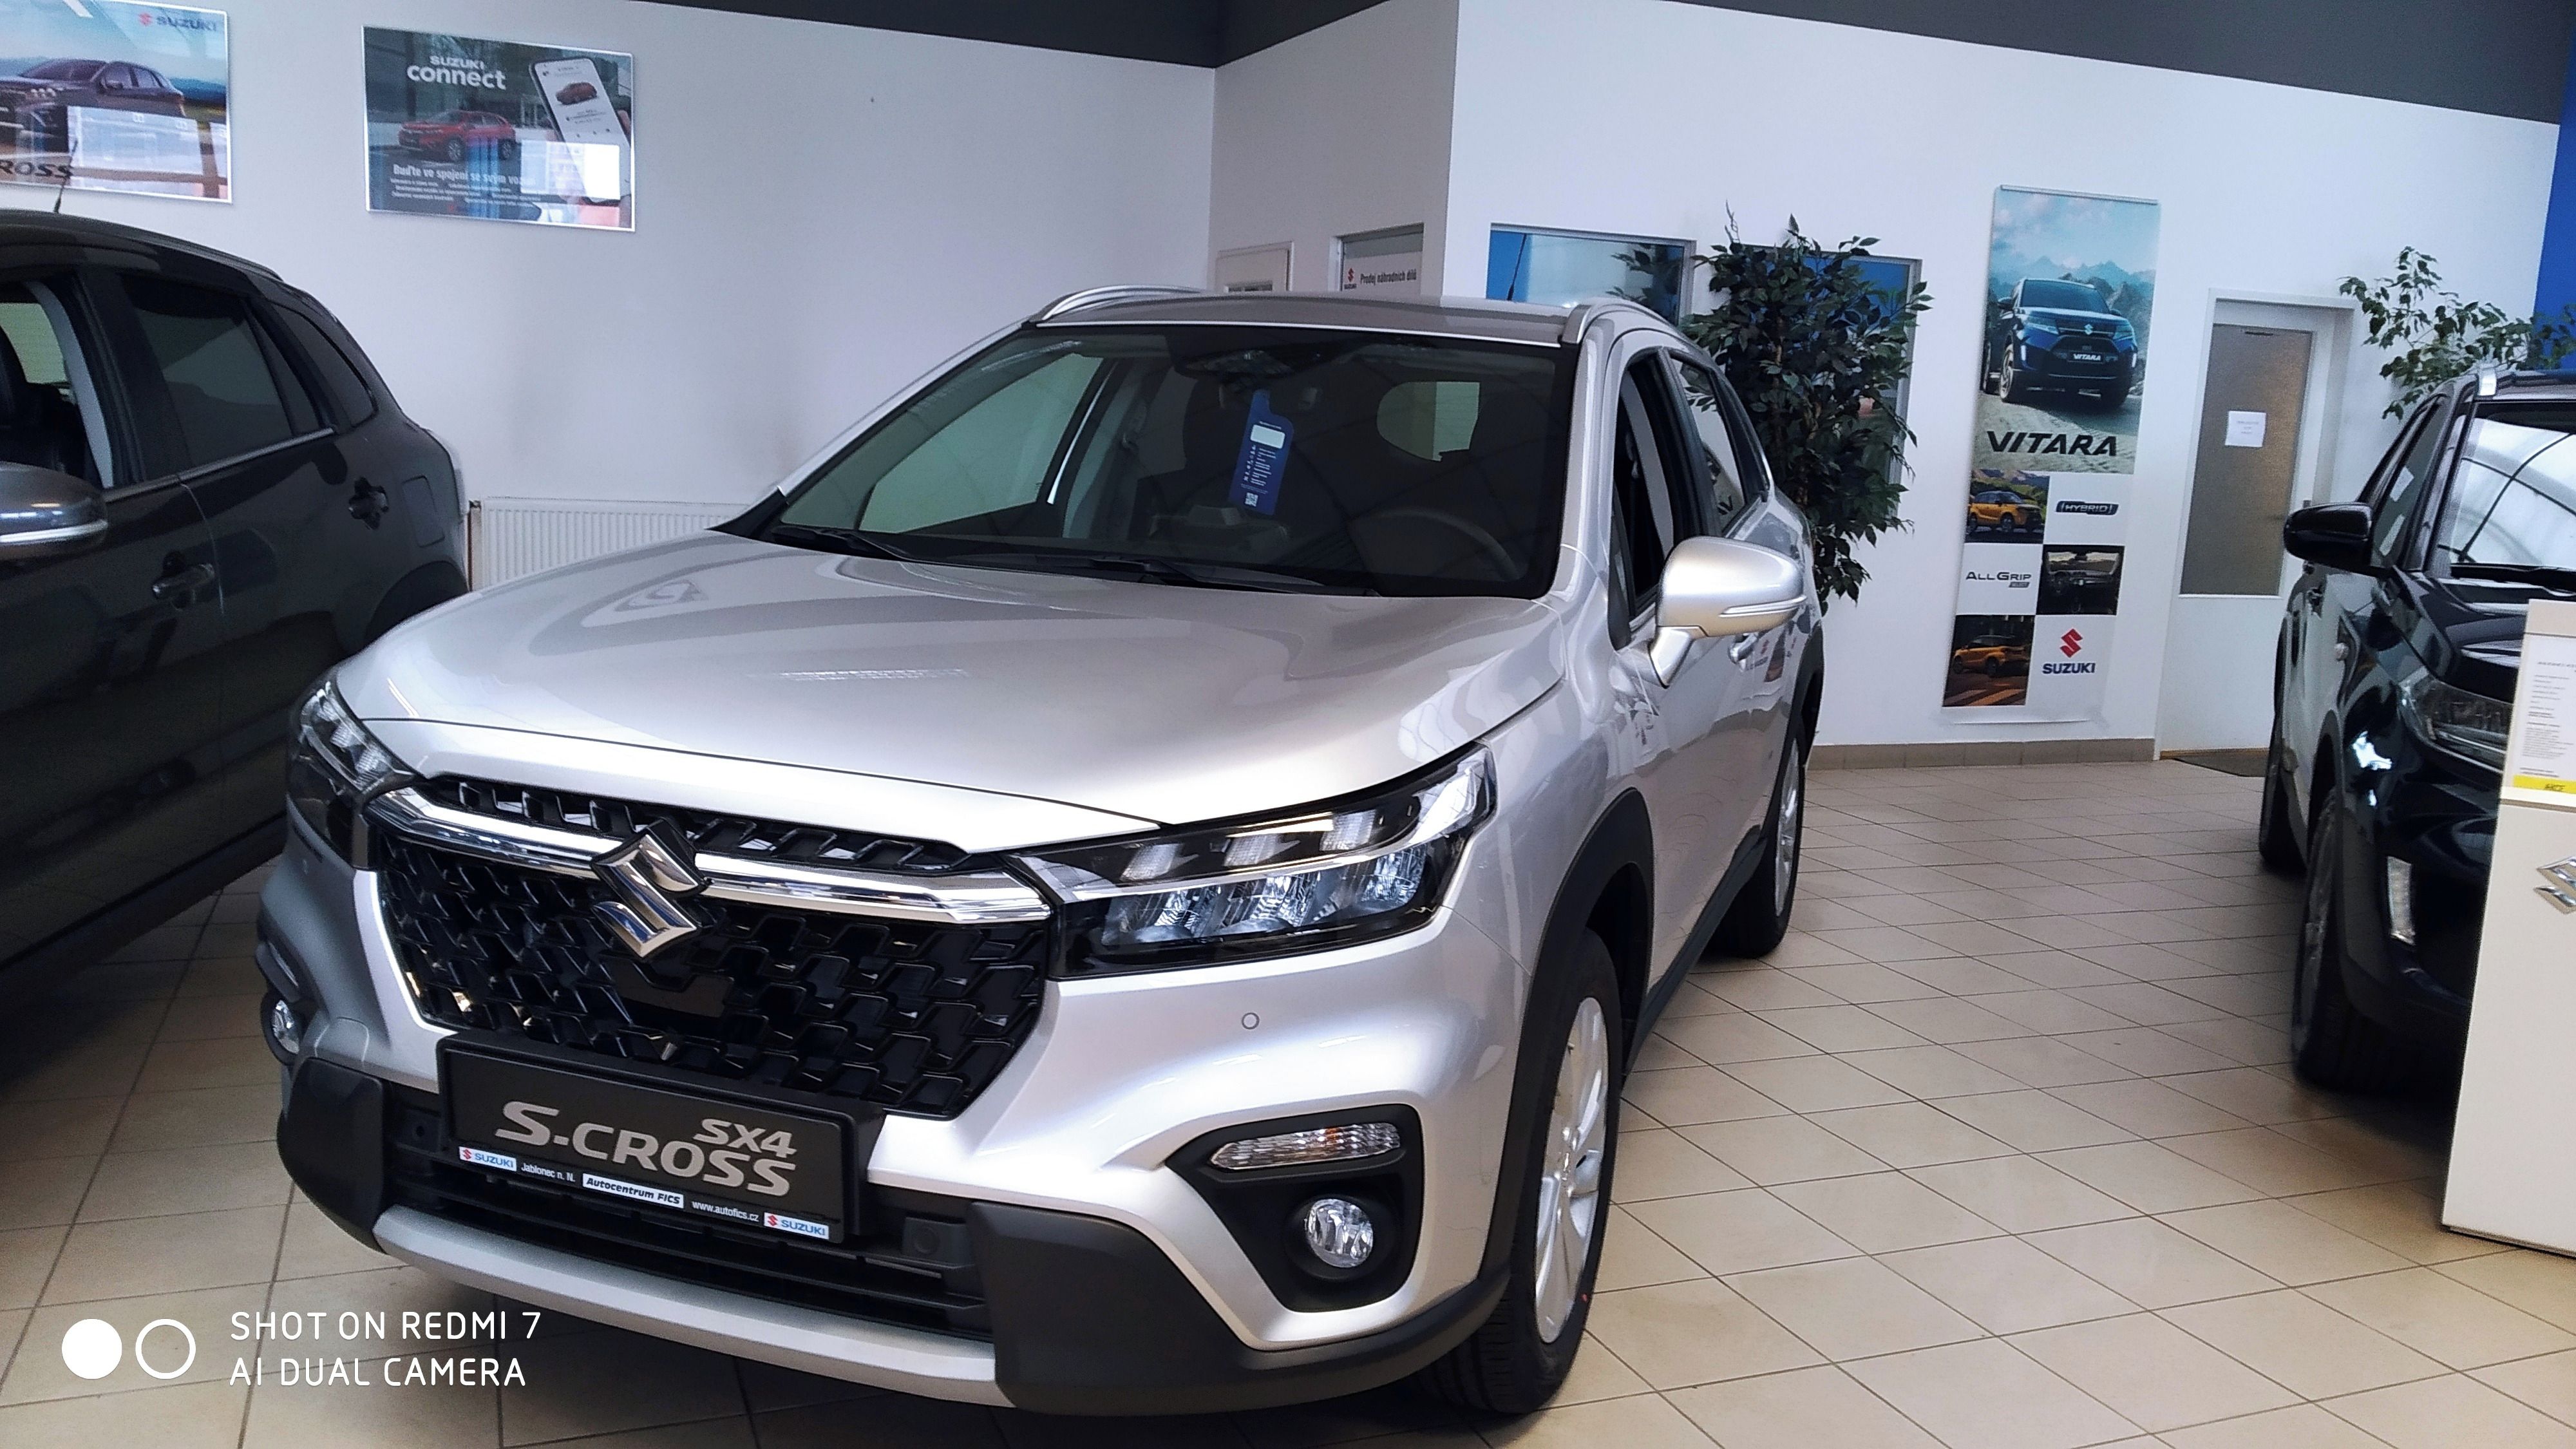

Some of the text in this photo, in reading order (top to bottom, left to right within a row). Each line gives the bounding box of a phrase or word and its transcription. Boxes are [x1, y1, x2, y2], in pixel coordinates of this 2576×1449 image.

[156, 15, 217, 32] SUZUKI
[429, 55, 484, 70] SUZUKI
[407, 65, 506, 90] connect
[1987, 431, 2117, 457] VITARA
[2042, 663, 2096, 674] SUZUKI
[692, 1119, 797, 1158] SX4
[495, 1101, 796, 1197] S-CROSS
[475, 1153, 514, 1168] SUZUKI
[520, 1162, 555, 1178] Jablonec
[557, 1171, 565, 1180] n.
[586, 1177, 681, 1204] Autocentrum FICS
[692, 1200, 760, 1222] www.autofics.cz
[781, 1219, 826, 1236] SUZUKI
